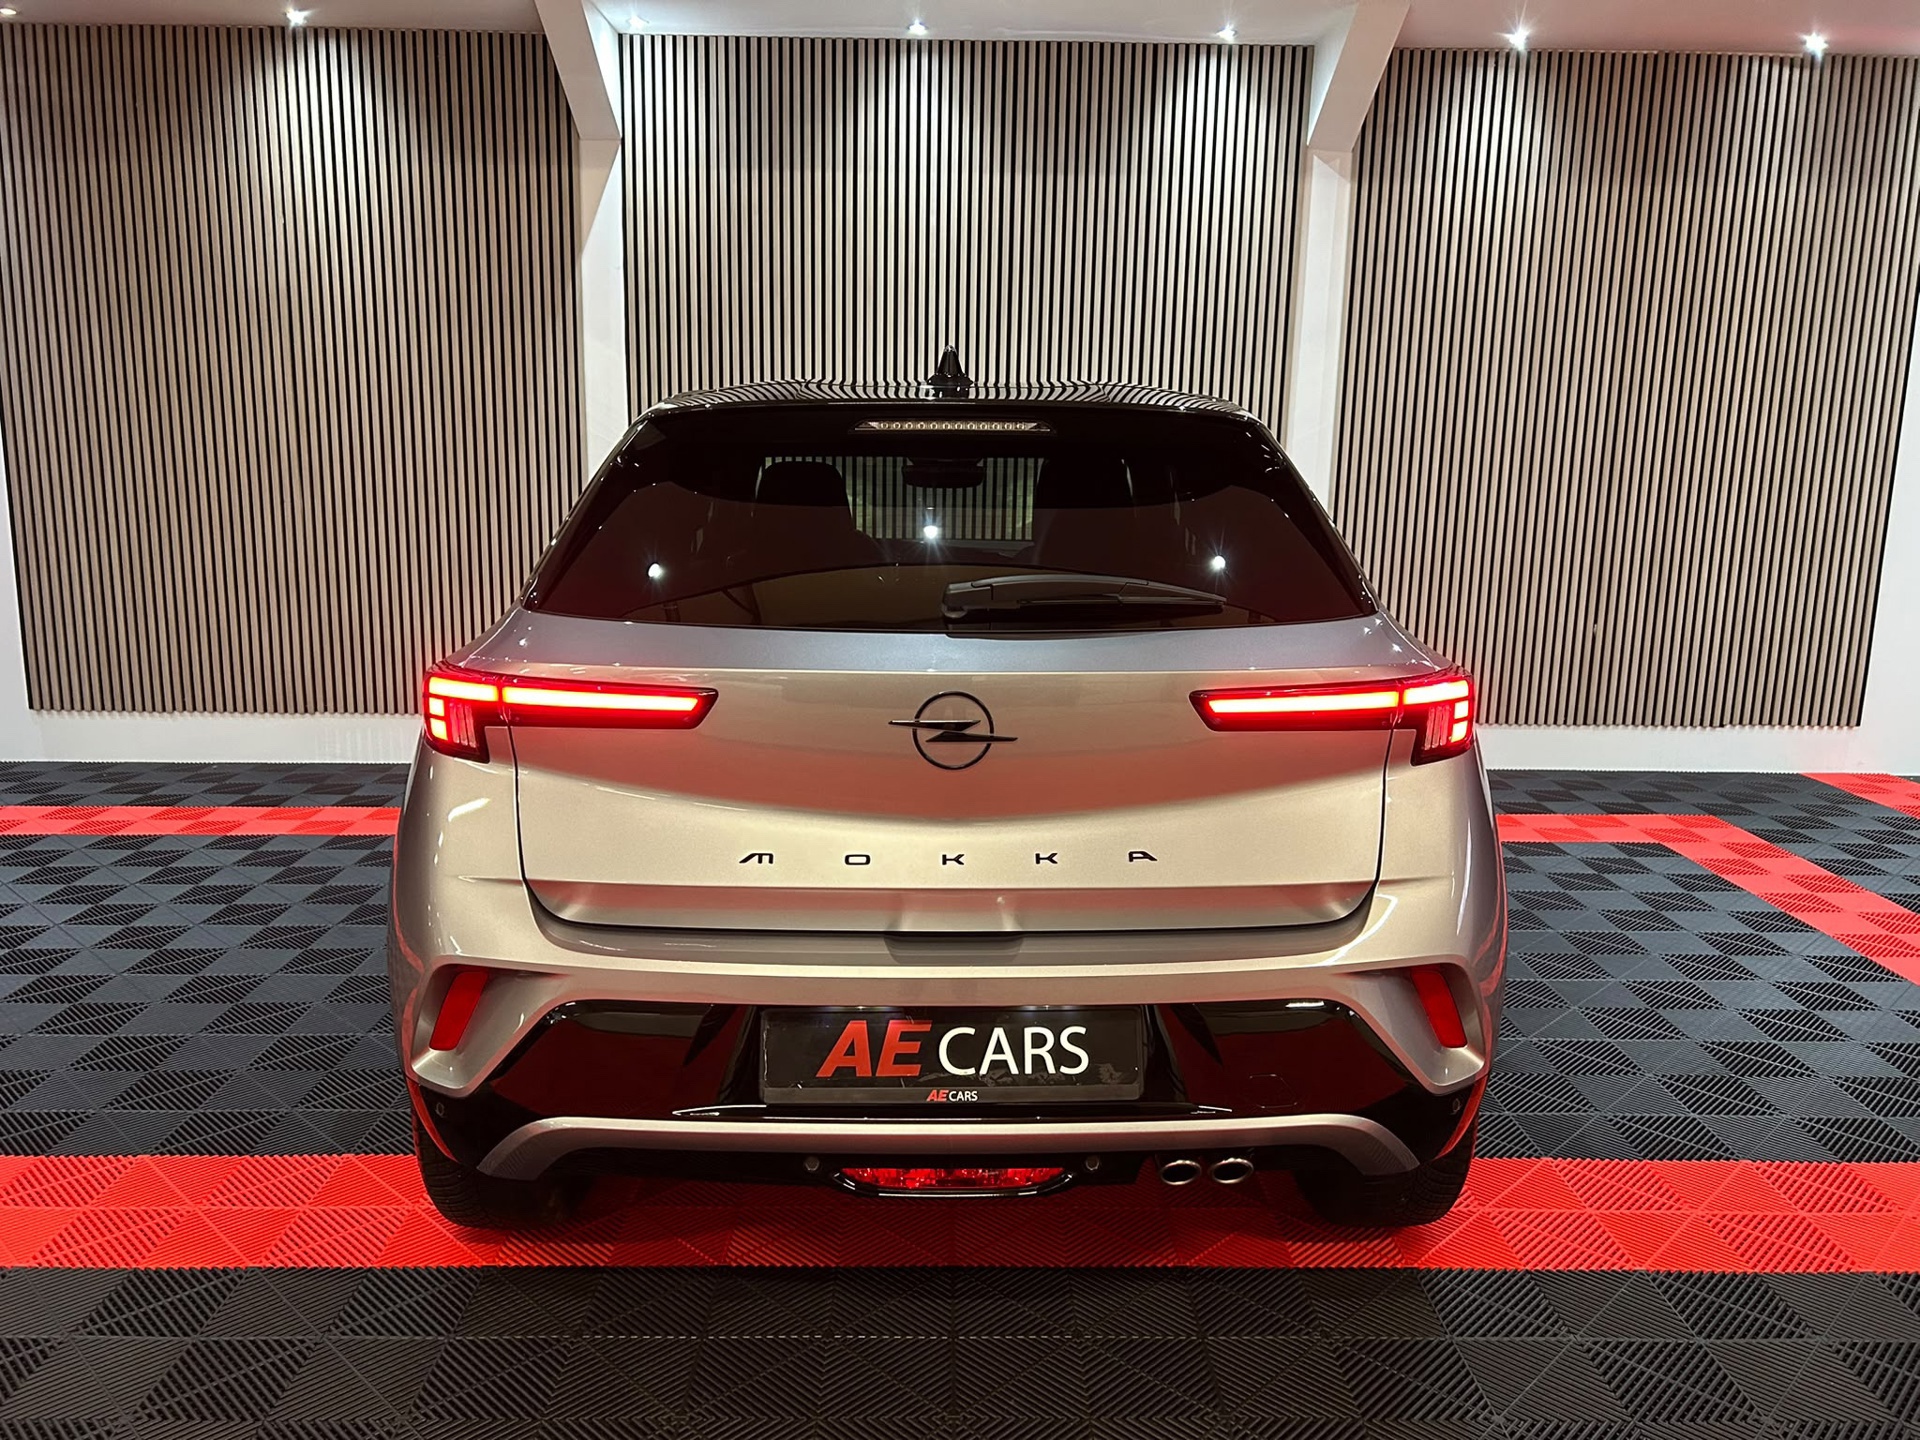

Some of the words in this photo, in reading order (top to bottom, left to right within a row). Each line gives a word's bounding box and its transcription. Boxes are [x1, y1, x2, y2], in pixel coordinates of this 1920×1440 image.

[739, 850, 1158, 866] MOKKA
[815, 1019, 932, 1078] AE
[938, 1026, 1090, 1076] CARS
[926, 1089, 949, 1102] AE
[949, 1090, 978, 1102] CARS
